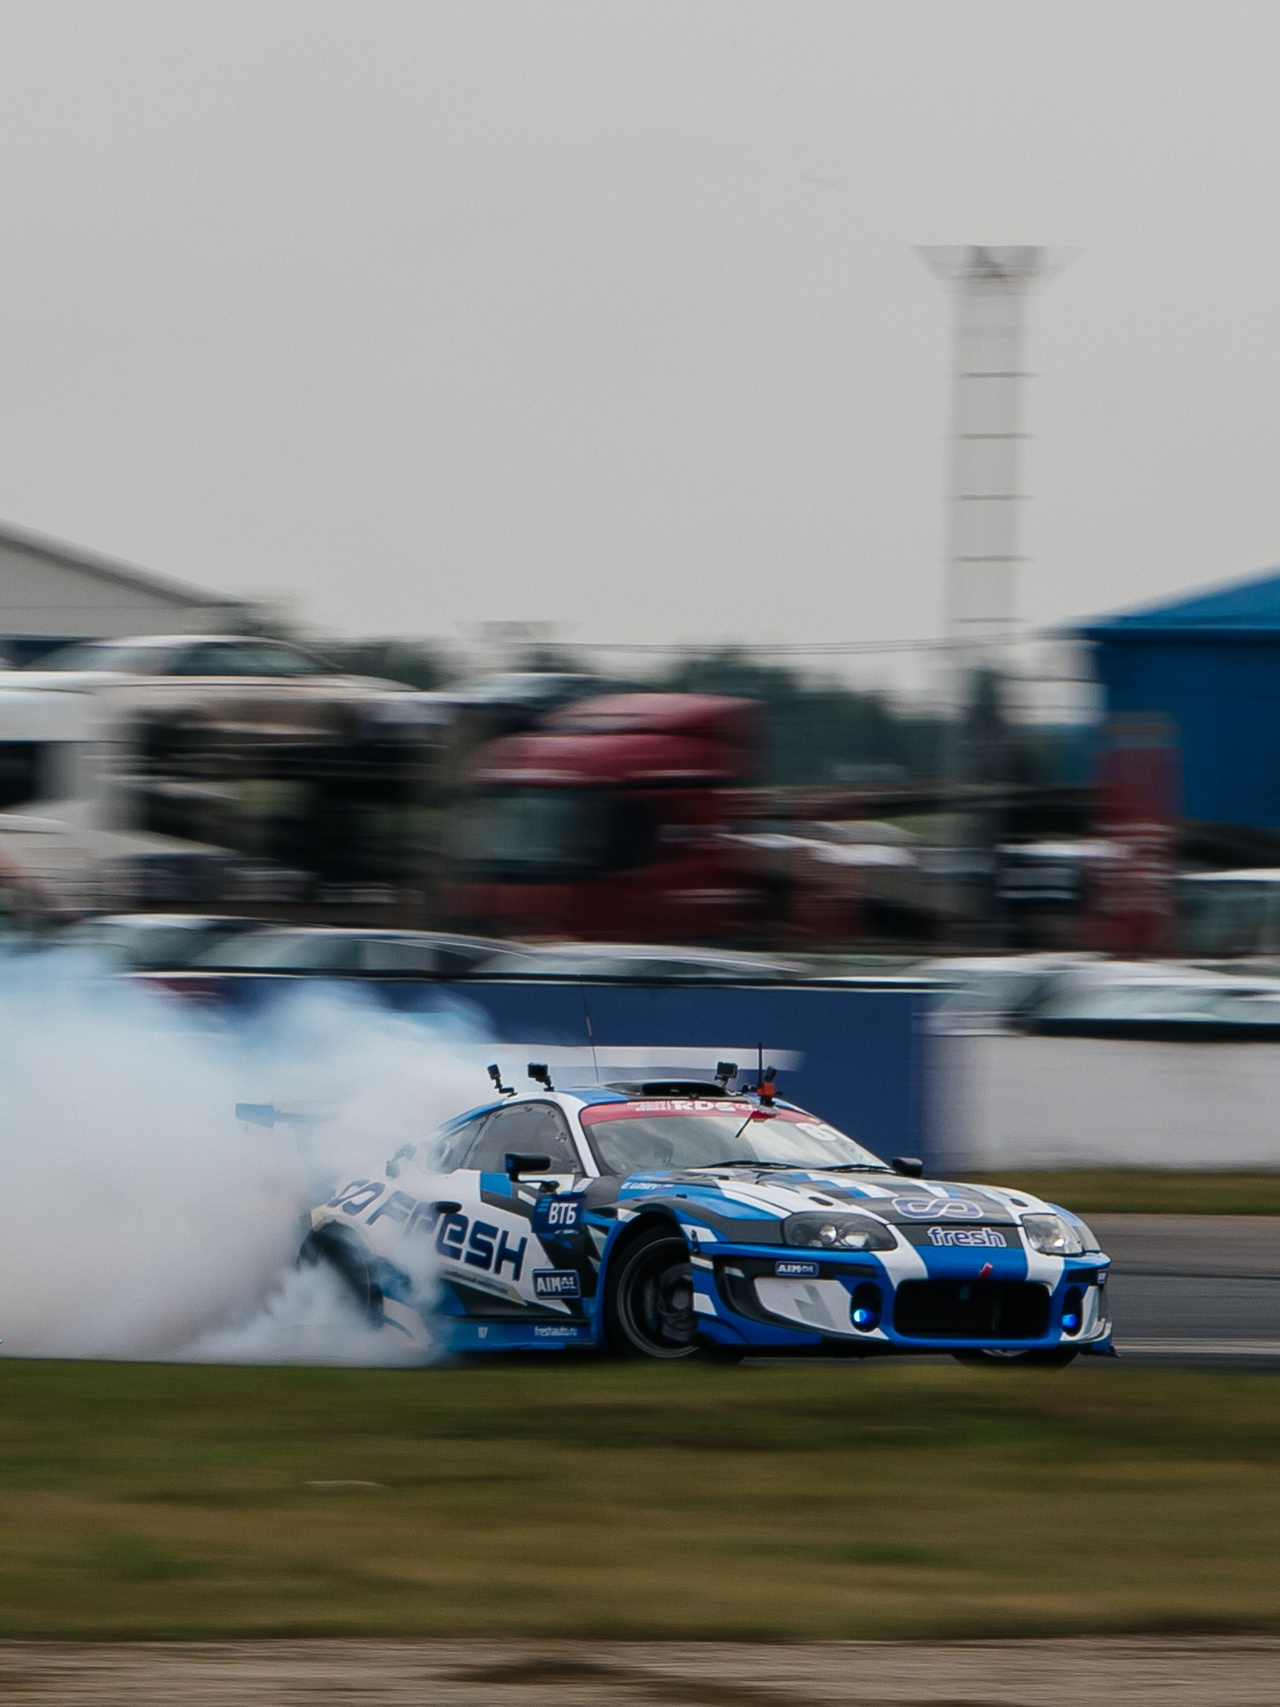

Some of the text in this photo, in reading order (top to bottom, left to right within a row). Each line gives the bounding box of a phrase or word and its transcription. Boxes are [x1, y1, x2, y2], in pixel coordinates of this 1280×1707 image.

[671, 1100, 736, 1111] RDS
[548, 1202, 579, 1225] ВТБ
[927, 1226, 1007, 1248] fresh
